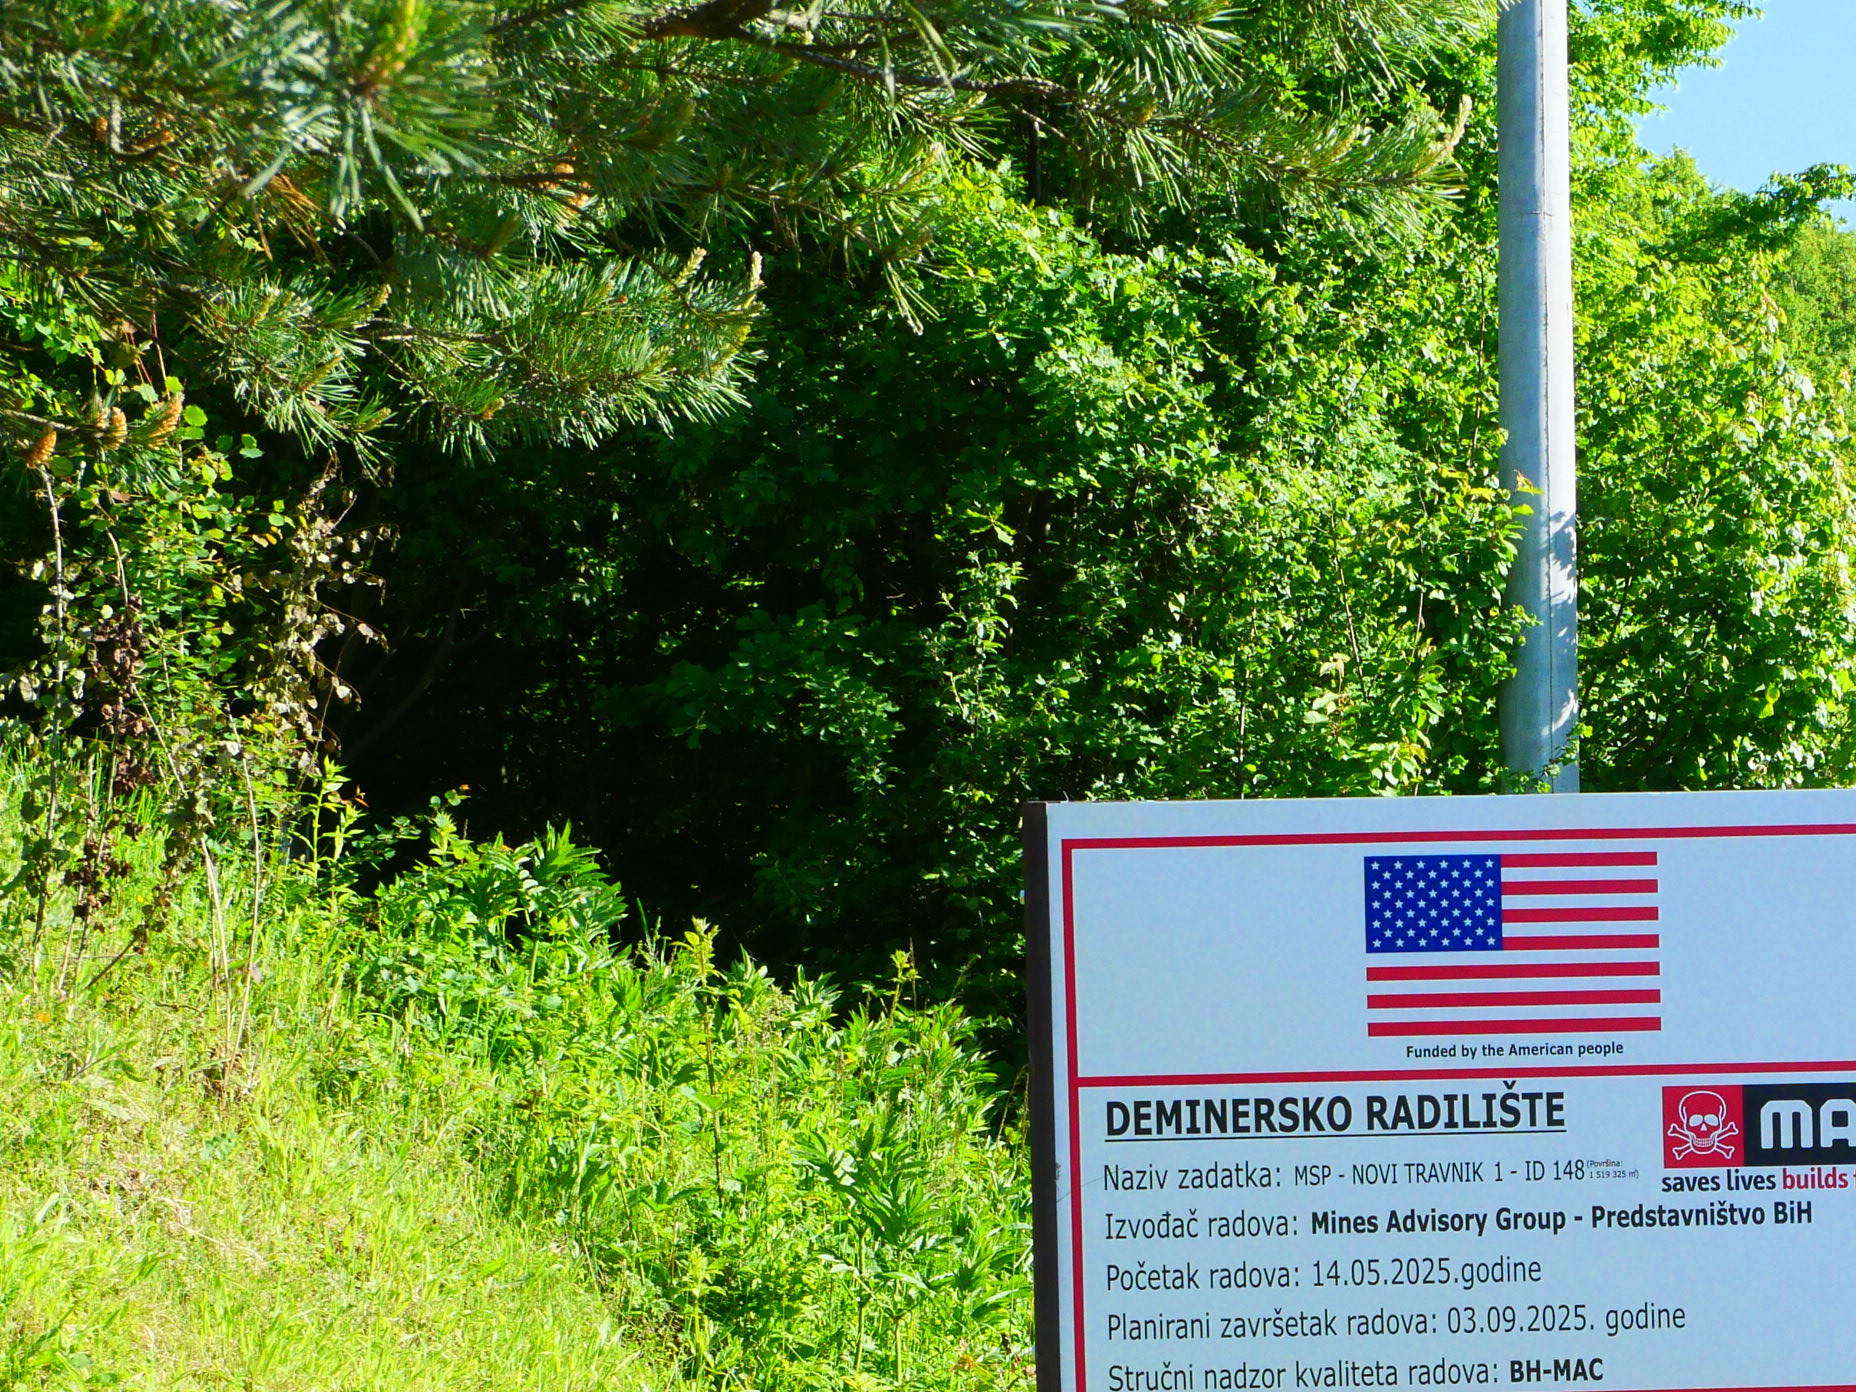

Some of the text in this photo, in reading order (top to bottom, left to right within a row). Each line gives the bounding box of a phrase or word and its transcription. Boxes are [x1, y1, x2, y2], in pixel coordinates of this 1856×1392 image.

[1406, 1041, 1624, 1060] Funded by the American people
[1106, 1080, 1565, 1136] DEMINERSKO RADILIŠTE
[1103, 1163, 1168, 1191] Naziv
[1177, 1160, 1281, 1189] zadatka:
[1295, 1164, 1331, 1186] MSP
[1352, 1163, 1398, 1185] NOVI
[1403, 1161, 1484, 1184] TRAVNIK
[1495, 1161, 1503, 1182] 1
[1525, 1160, 1545, 1181] ID
[1553, 1159, 1585, 1181] 148
[1661, 1171, 1721, 1192] saves
[1726, 1168, 1776, 1191] lives
[1782, 1167, 1849, 1189] builds
[1105, 1208, 1199, 1240] Izvođač
[1208, 1209, 1298, 1238] radova:
[1311, 1210, 1379, 1235] Mines
[1386, 1208, 1488, 1237] Advisory
[1495, 1207, 1566, 1235] Group
[1592, 1200, 1765, 1229] Predstavništvo
[1774, 1200, 1813, 1224] BiH
[1106, 1255, 1542, 1291] Početak radova: 14.05.2025.godine
[1108, 1302, 1686, 1341] Planirani završetak radova: 03.09.2025. godine
[1108, 1357, 1604, 1392] Stručni nadzor kvaliteta radova: BH-MAC
